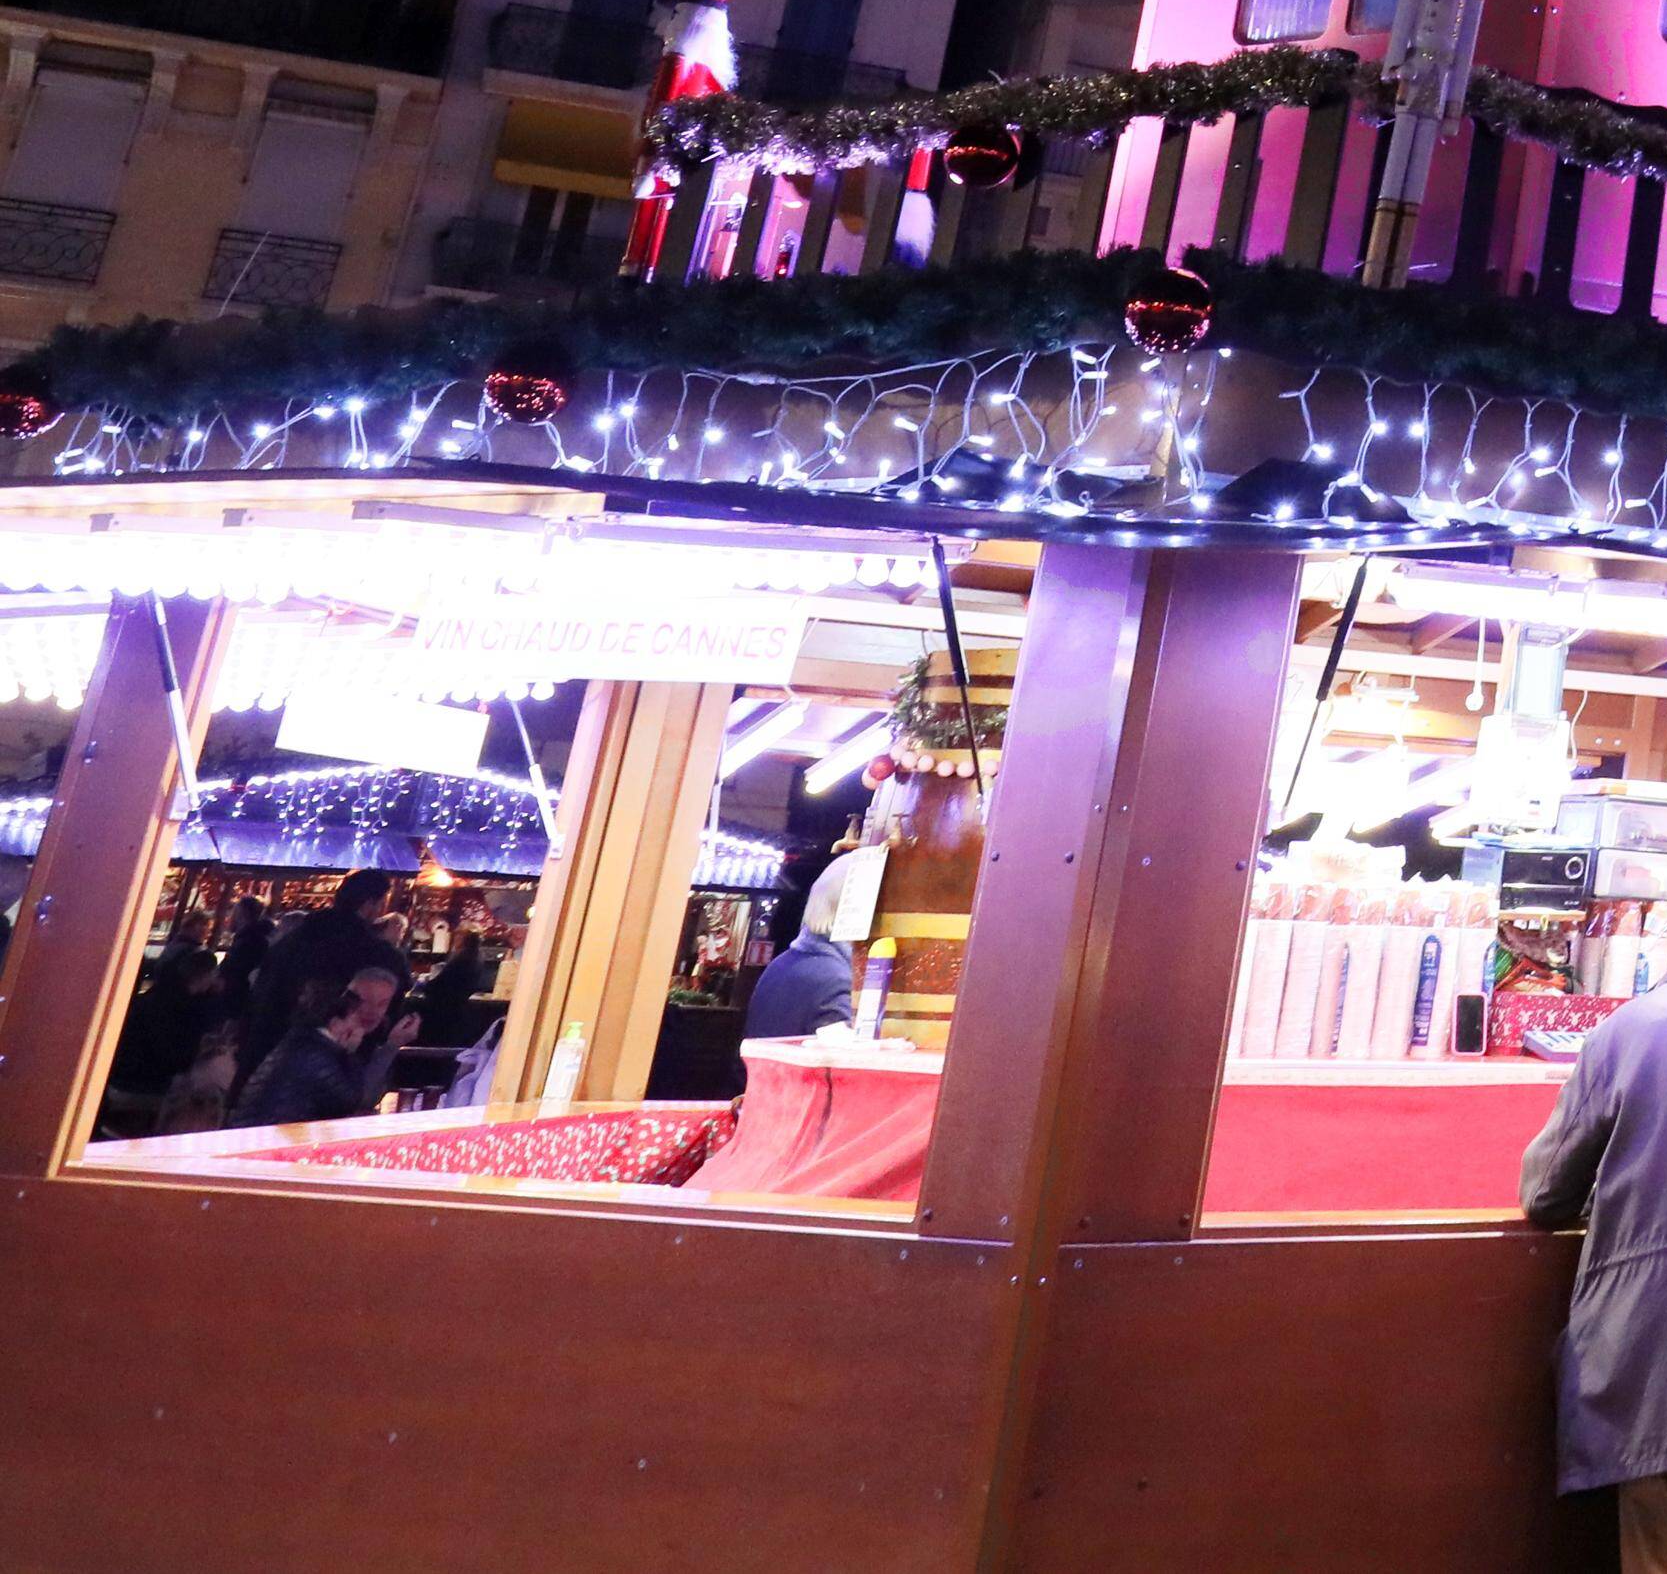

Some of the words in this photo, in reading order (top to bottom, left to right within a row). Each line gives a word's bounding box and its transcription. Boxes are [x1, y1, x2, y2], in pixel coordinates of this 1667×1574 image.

[424, 619, 473, 650] VIN
[480, 620, 592, 652] CHAUD
[598, 622, 645, 654] DE
[651, 623, 788, 658] CANNES
